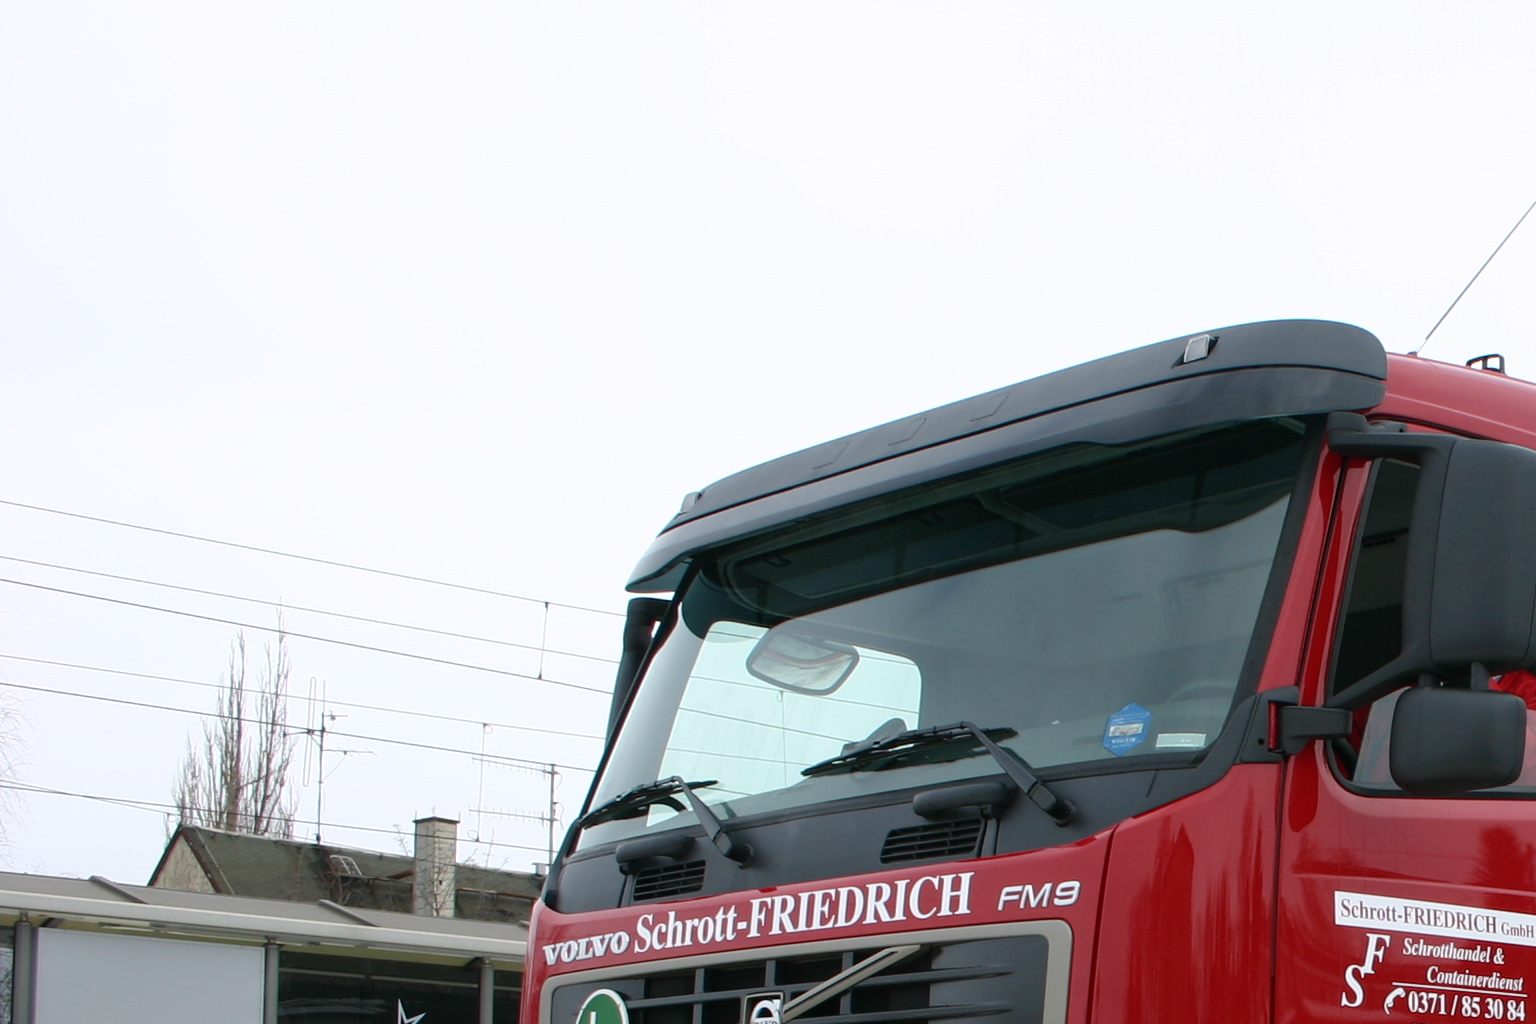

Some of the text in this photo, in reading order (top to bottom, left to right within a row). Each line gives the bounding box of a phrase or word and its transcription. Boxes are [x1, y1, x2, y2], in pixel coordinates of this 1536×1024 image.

[543, 872, 1081, 966] VOLVO Schrott-FRIEDRICH FM9
[1340, 898, 1535, 939] Schrott-FRIEDRICH GmbH
[1363, 932, 1391, 975] F
[1403, 938, 1505, 965] Schrotthandel &
[1341, 964, 1365, 1008] S
[1427, 966, 1524, 991] Containerdienst
[1408, 991, 1447, 1015] 0371
[1461, 996, 1481, 1018] 85
[1484, 998, 1503, 1020] 30
[1507, 1000, 1526, 1022] 84
